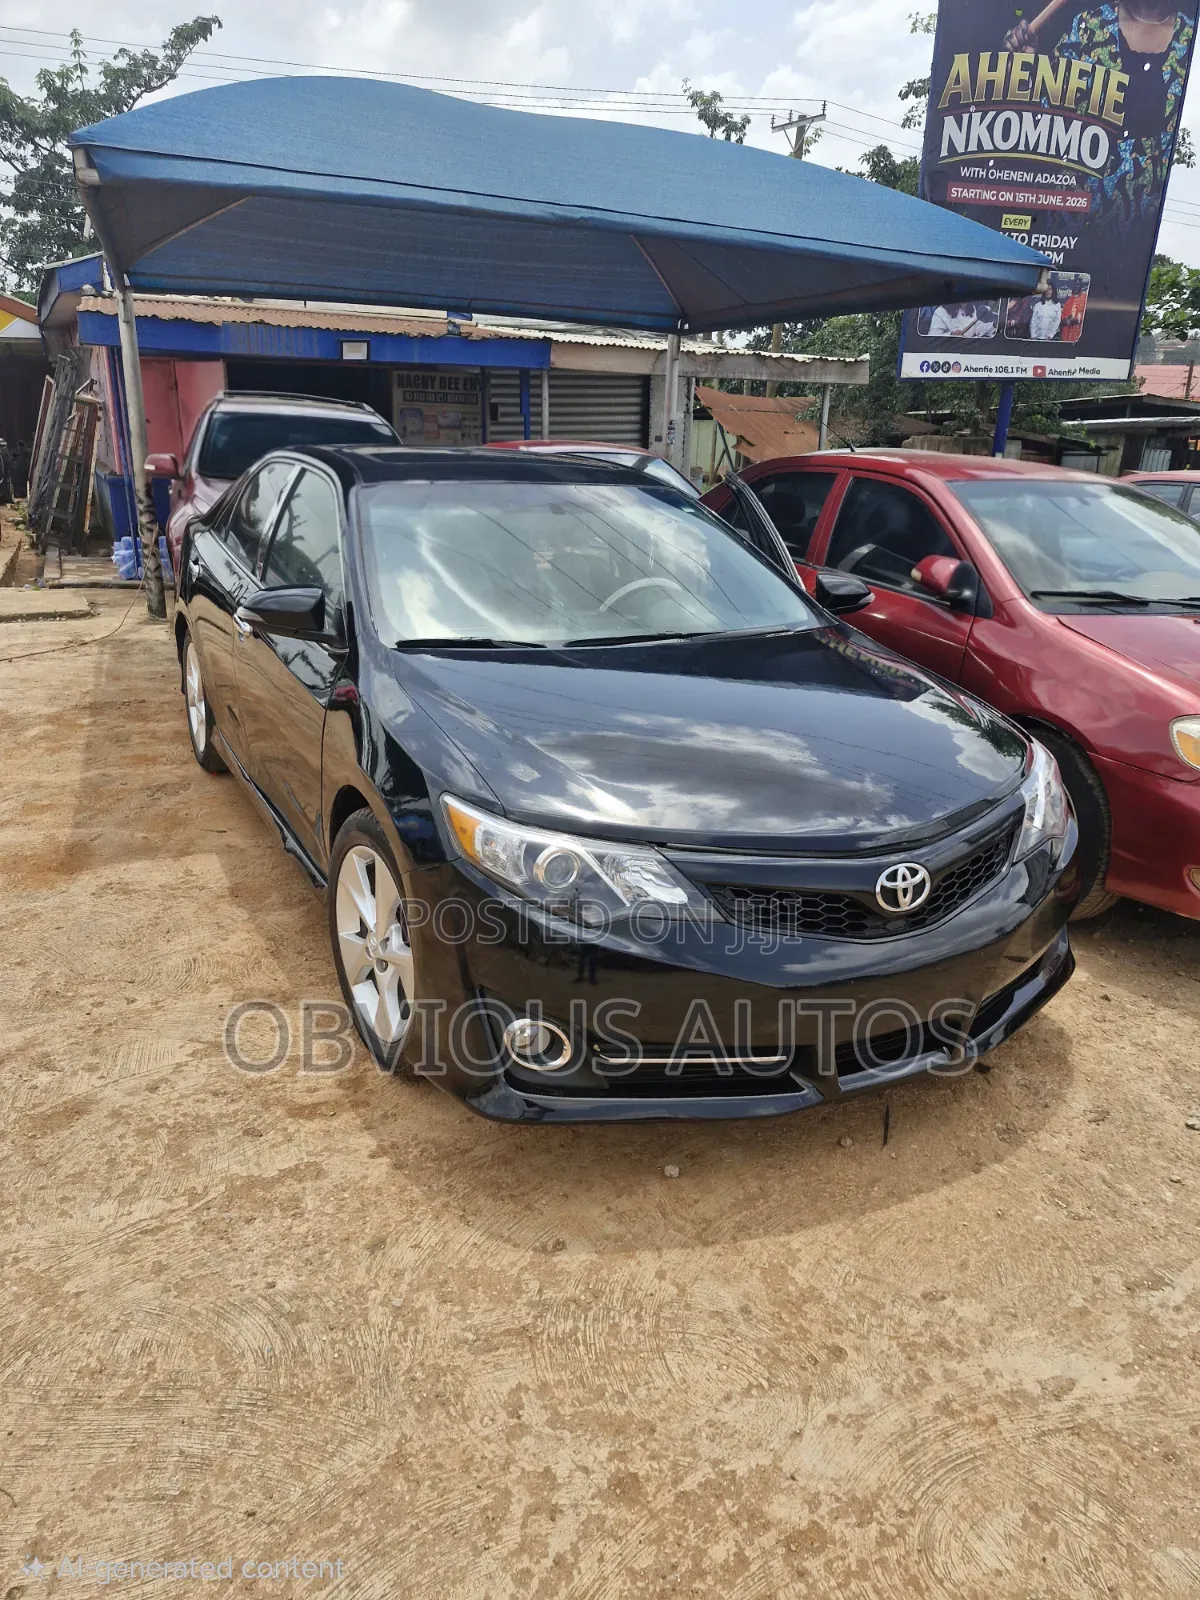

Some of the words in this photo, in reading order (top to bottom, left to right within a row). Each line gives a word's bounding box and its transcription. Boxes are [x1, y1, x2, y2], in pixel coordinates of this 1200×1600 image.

[938, 51, 1130, 126] AHENFIE
[939, 110, 1110, 169] NKOMMO
[960, 166, 986, 179] WITH
[988, 169, 1033, 183] OHENENI
[1034, 172, 1077, 186] ADAZOA
[950, 187, 997, 201] STARTING
[998, 191, 1014, 202] ON
[1015, 192, 1037, 204] 15TH
[1037, 194, 1064, 207] JUNE,
[1065, 196, 1088, 208] 2026
[1003, 217, 1029, 227] EVERY
[1030, 233, 1078, 250] FRIDAY
[963, 365, 993, 374] Ahenfie
[994, 366, 1015, 374] 106.1
[1078, 367, 1101, 375] Media
